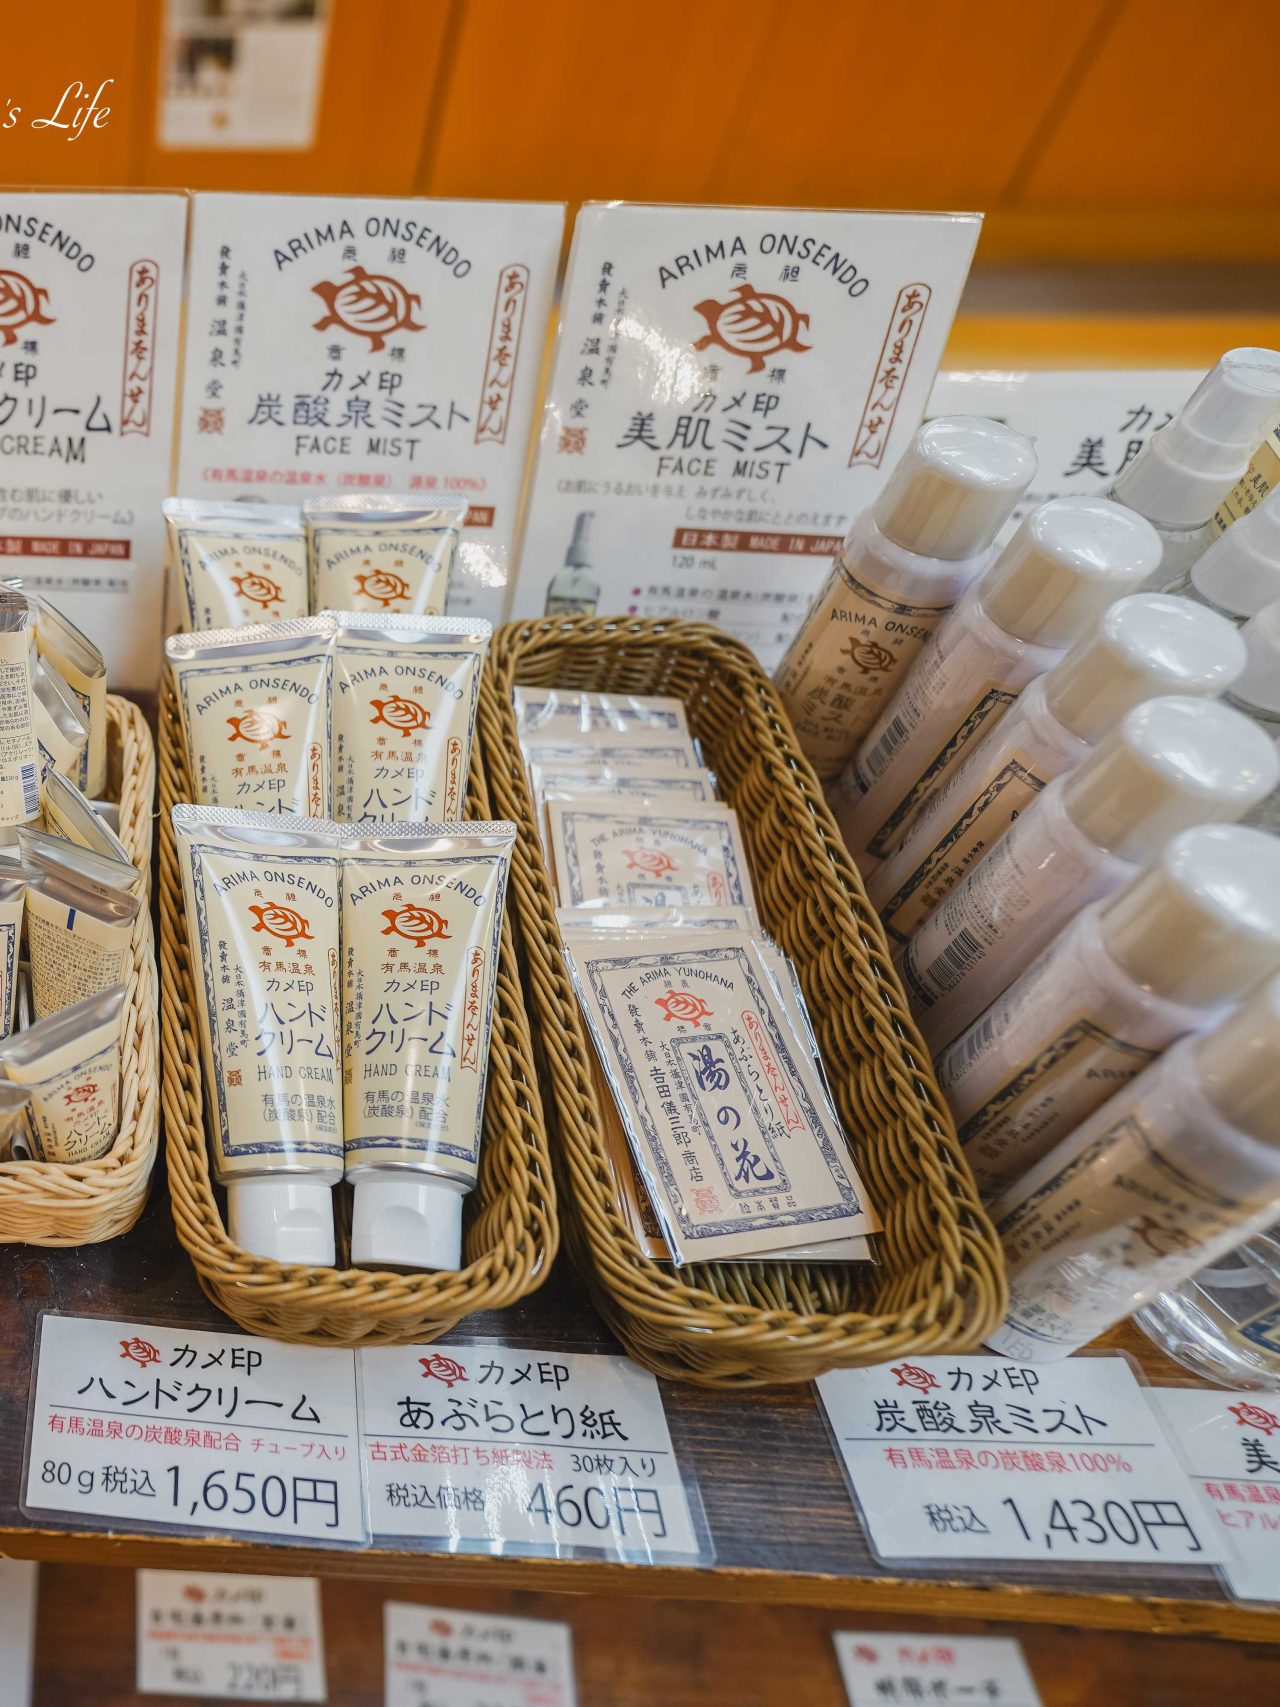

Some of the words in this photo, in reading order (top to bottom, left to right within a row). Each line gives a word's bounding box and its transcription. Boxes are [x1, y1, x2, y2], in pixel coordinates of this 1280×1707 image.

[273, 219, 355, 272] ARIMA
[365, 217, 472, 279] ONSENDO
[659, 236, 747, 291] ARIMA
[759, 233, 870, 299] ONSENDO
[320, 368, 403, 395] カメ印
[248, 392, 470, 431] 炭酸泉ミスト
[692, 392, 780, 419] カメ印
[0, 435, 86, 464] CREAM
[294, 435, 351, 457] FACE
[367, 436, 421, 462] MIST
[617, 411, 829, 460] 美肌ミスト
[655, 457, 716, 478] FACE
[733, 459, 791, 484] MIST
[31, 540, 61, 555] MADE
[67, 541, 84, 556] IN
[88, 543, 126, 557] JAPAN
[680, 531, 738, 549] 日本製
[748, 534, 780, 550] MADE
[788, 536, 806, 551] IN
[242, 545, 304, 577] ONSENDO
[324, 543, 373, 570] ARIMA
[378, 542, 441, 574] ONSENDO
[671, 553, 695, 570] 120
[831, 607, 877, 630] ARIMA
[195, 683, 243, 716] ARIMA
[249, 678, 319, 705] ONSENDO
[338, 665, 389, 695] ARIMA
[394, 665, 464, 701] ONSENDO
[236, 778, 286, 796] カメ印
[374, 765, 425, 783] カメ印
[362, 787, 437, 809] ハンド
[611, 826, 645, 839] ARIMA
[213, 869, 260, 897] ARIMA
[263, 870, 334, 909] ONSENDO
[349, 875, 404, 906] ARIMA
[411, 874, 486, 907] ONSENDO
[258, 961, 316, 976] 有馬温泉
[380, 962, 445, 975] 有馬温泉
[266, 978, 314, 994] カメ印
[383, 979, 440, 995] カメ印
[620, 981, 639, 1001] THE
[639, 968, 672, 986] ARIMA
[674, 966, 735, 992] YUNOHANA
[259, 1002, 327, 1028] ハンド
[371, 1001, 453, 1026] ハンド
[255, 1028, 333, 1060] クリーム
[365, 1028, 457, 1058] クリーム
[257, 1065, 292, 1082] HAND
[298, 1066, 333, 1084] CREAM
[363, 1063, 398, 1080] HAND
[404, 1065, 451, 1083] CREAM
[731, 1026, 791, 1139] あぶらとり紙
[262, 1094, 336, 1110] 有馬の温泉水
[364, 1090, 450, 1108] 有馬の温泉水
[316, 1111, 336, 1126] 配合
[686, 1044, 774, 1184] 湯の花
[64, 1122, 111, 1151] クリーム
[170, 1344, 262, 1376] カメ印
[479, 1360, 569, 1390] カメ印
[947, 1367, 1039, 1395] カメ印
[77, 1377, 320, 1423] ハンドクリーム
[398, 1396, 629, 1441] あぶらとり紙
[875, 1399, 1107, 1436] 炭酸泉ミスト
[48, 1414, 241, 1452] 有馬温泉の炭酸泉配合
[250, 1438, 346, 1460] チューブ入り
[368, 1442, 554, 1472] 古式金箔打ち紙製法
[572, 1455, 655, 1478] 30枚入り
[884, 1447, 1133, 1473] 有馬温泉の炭酸泉100%
[101, 1465, 155, 1497] 税込
[166, 1465, 339, 1528] 1,650円
[386, 1483, 485, 1511] 税込価格
[526, 1483, 667, 1538] 460円
[923, 1503, 991, 1535] 税込
[1003, 1498, 1201, 1551] 1,430円
